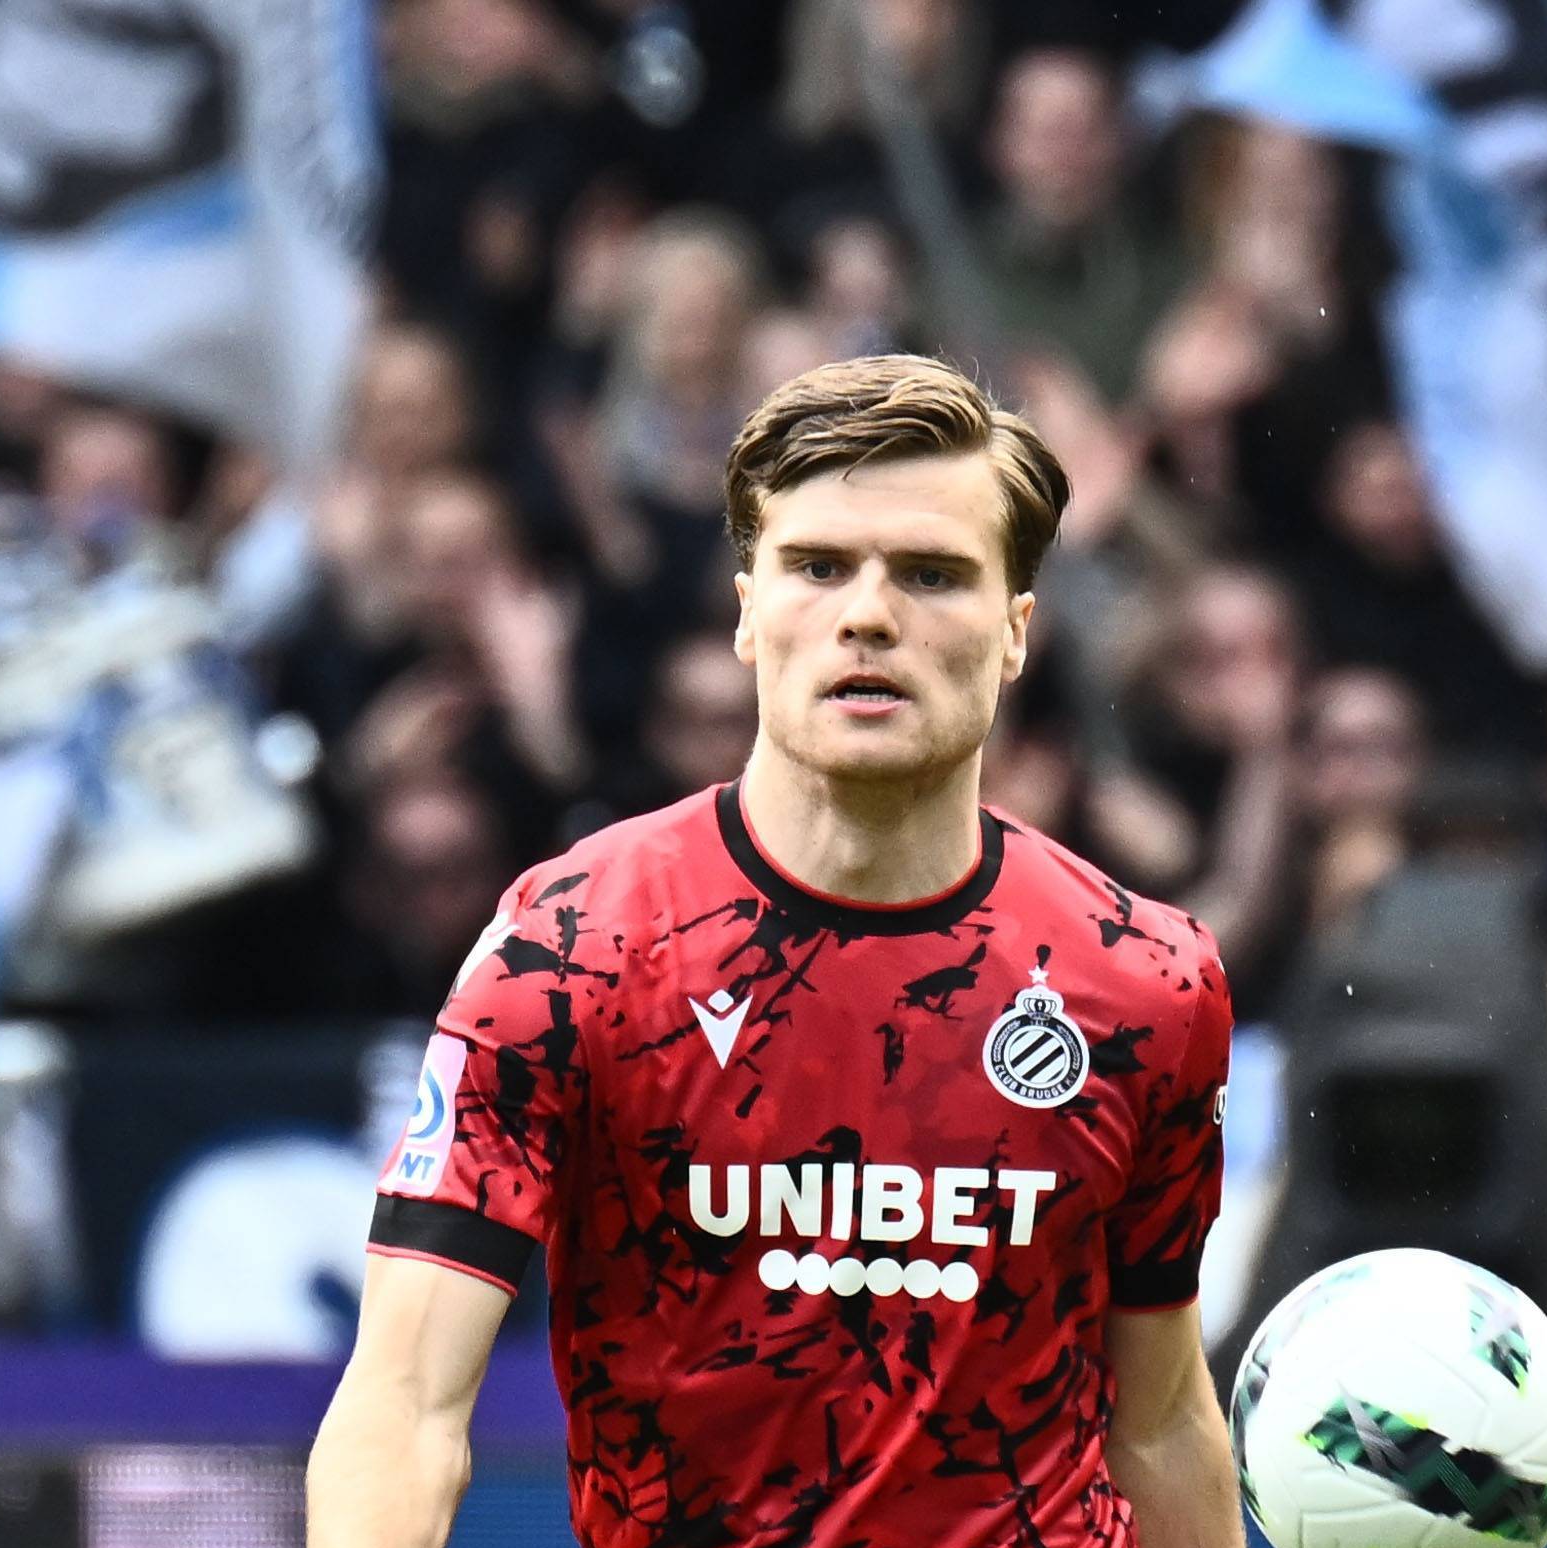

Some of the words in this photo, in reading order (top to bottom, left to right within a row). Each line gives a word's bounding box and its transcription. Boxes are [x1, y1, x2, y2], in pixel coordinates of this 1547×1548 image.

[995, 1064, 1017, 1090] CLUB
[1020, 1084, 1065, 1099] BRUGGE
[688, 1163, 1057, 1247] UNIBET
